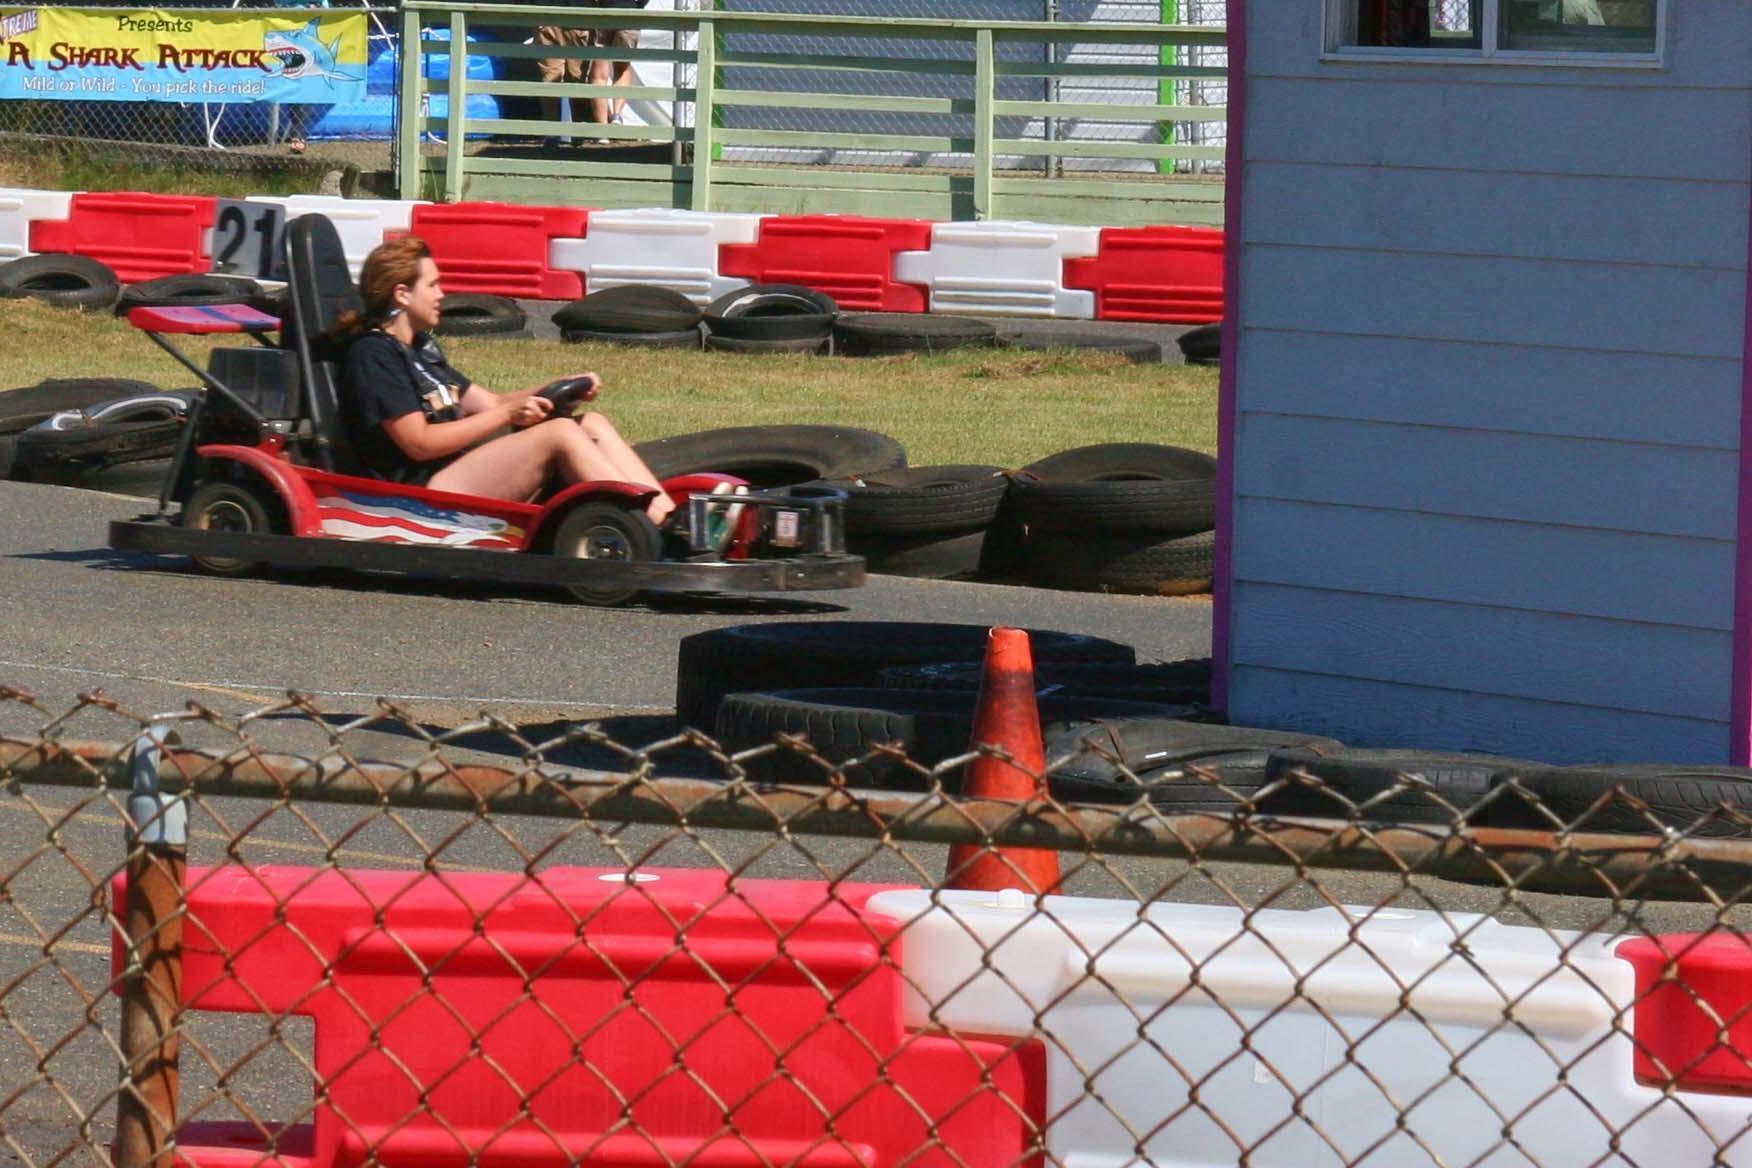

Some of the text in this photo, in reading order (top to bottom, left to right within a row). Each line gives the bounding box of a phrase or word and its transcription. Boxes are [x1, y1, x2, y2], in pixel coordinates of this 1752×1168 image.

[118, 15, 193, 32] Presents
[7, 41, 35, 70] A
[23, 77, 55, 91] Mild
[60, 80, 76, 91] or
[81, 78, 116, 92] Wild
[132, 78, 161, 93] You
[166, 79, 198, 96] pick
[202, 79, 227, 94] the
[231, 79, 265, 94] ride!
[216, 206, 277, 280] 21
